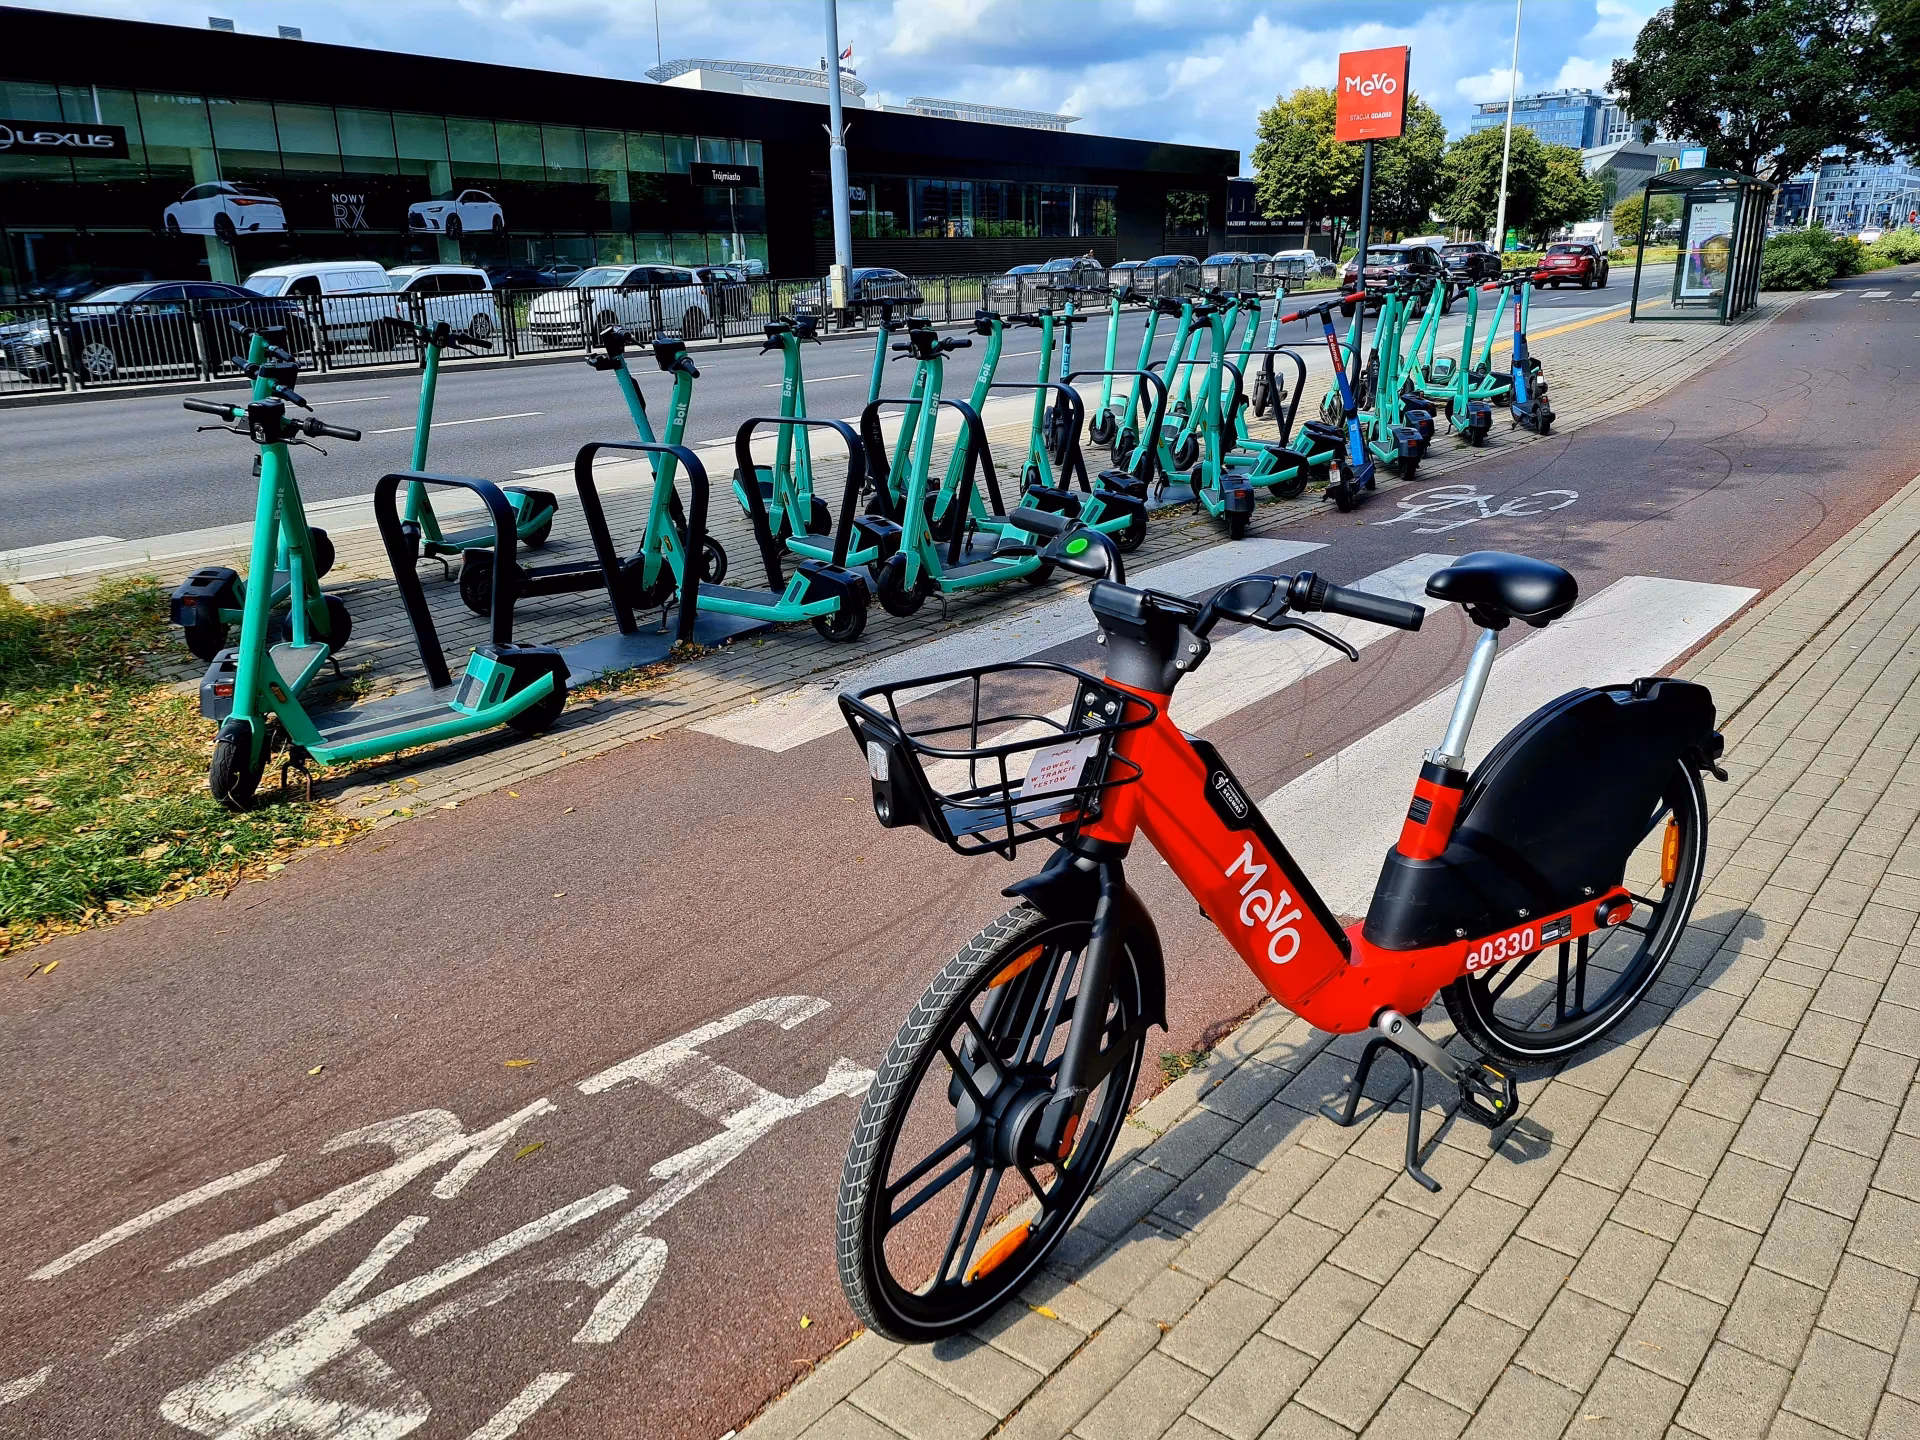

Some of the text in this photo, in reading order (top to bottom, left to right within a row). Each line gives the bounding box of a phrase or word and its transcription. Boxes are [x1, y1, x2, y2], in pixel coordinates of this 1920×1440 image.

[1345, 73, 1397, 96] MeVo
[16, 131, 114, 148] LEXUS
[712, 170, 740, 182] Trójmiasto
[332, 194, 364, 203] NOWY
[333, 205, 369, 228] RX
[1170, 340, 1180, 356] Bolt
[1063, 345, 1071, 374] TIER
[1211, 352, 1219, 369] Bolt
[979, 363, 991, 384] Bolt
[783, 377, 793, 398] Bolt
[673, 402, 687, 426] Bolt
[929, 393, 940, 416] Bolt
[274, 487, 285, 520] Bolt
[1041, 760, 1070, 773] ROWER
[1041, 765, 1077, 780] TRAKCIE
[1222, 788, 1242, 814] SEGWAY
[1225, 841, 1302, 964] MeVo
[1466, 928, 1534, 970] e0330
